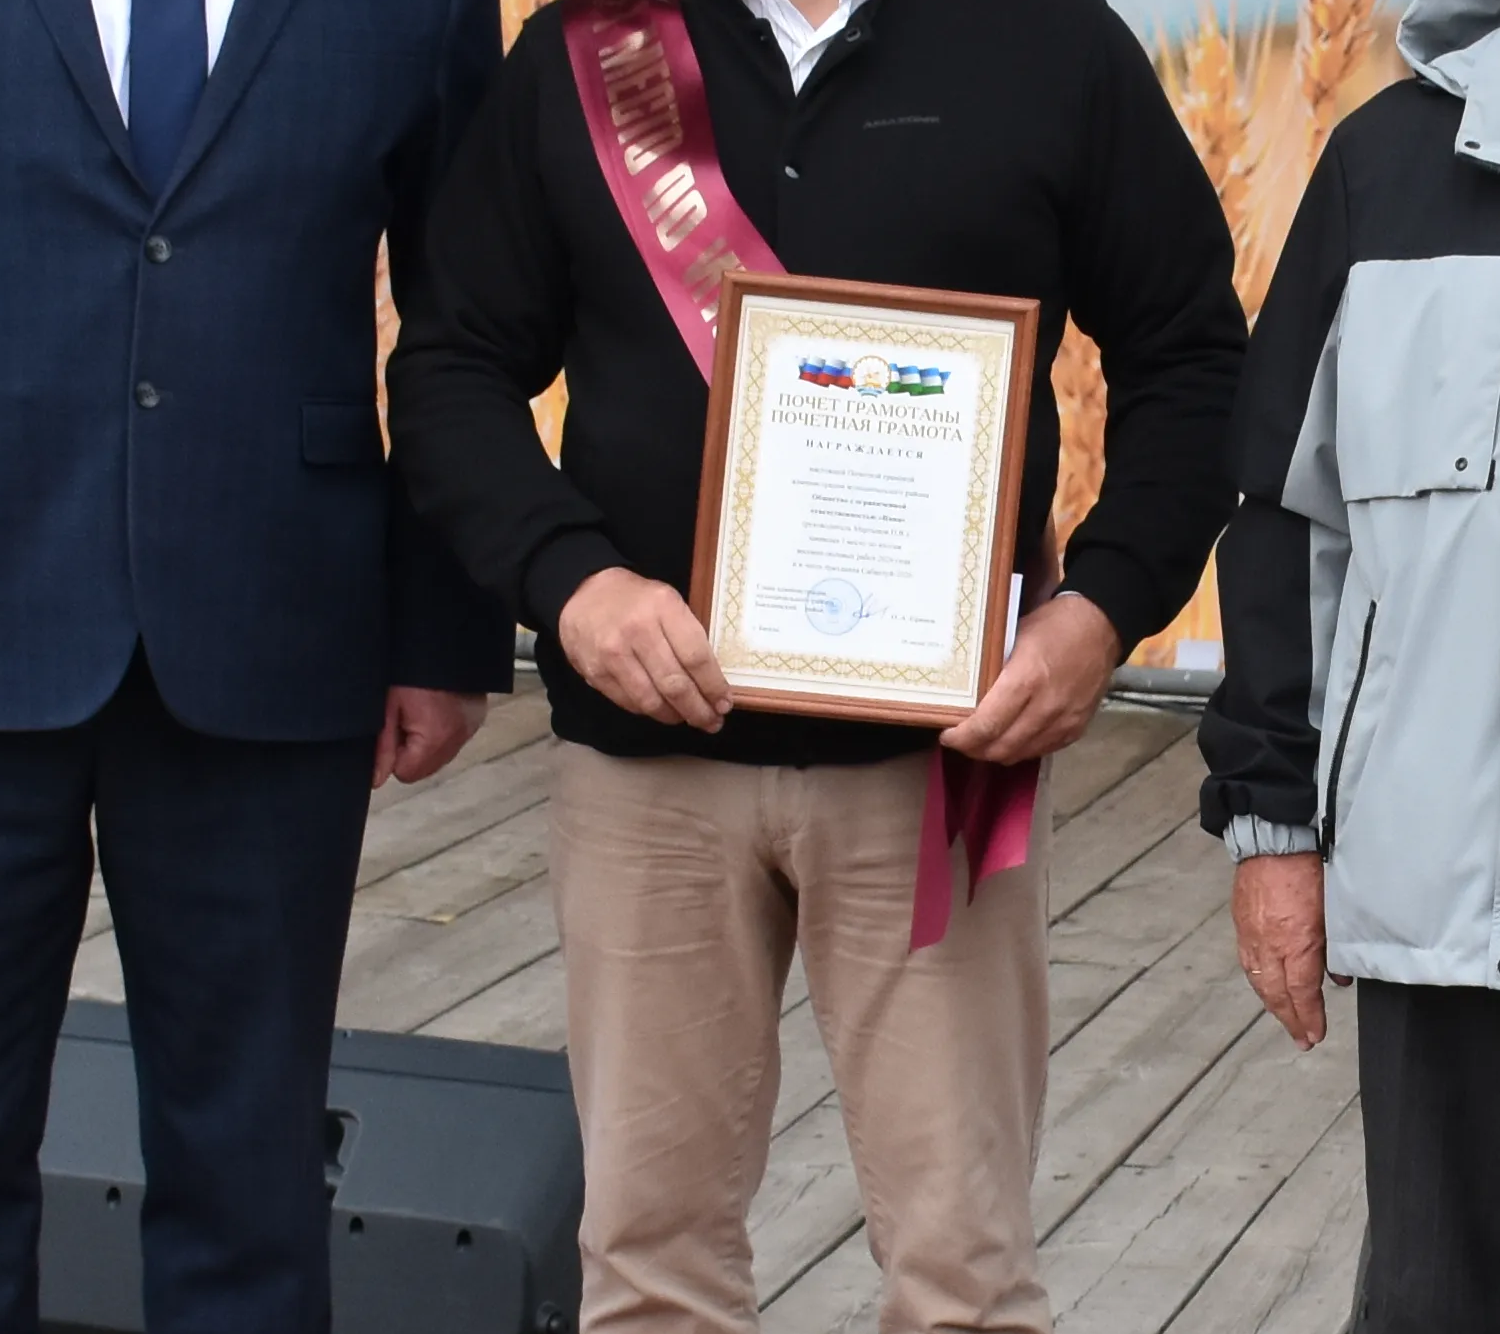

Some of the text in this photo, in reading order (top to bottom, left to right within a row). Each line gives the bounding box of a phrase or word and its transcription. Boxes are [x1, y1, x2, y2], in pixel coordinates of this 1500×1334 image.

[642, 162, 708, 253] ПО
[778, 392, 842, 412] ПОЧЕТ
[771, 409, 964, 443] ПОЧЕТНАЯ ГРАМОТА
[806, 439, 924, 459] НАГРАЖДАЕТСЯ
